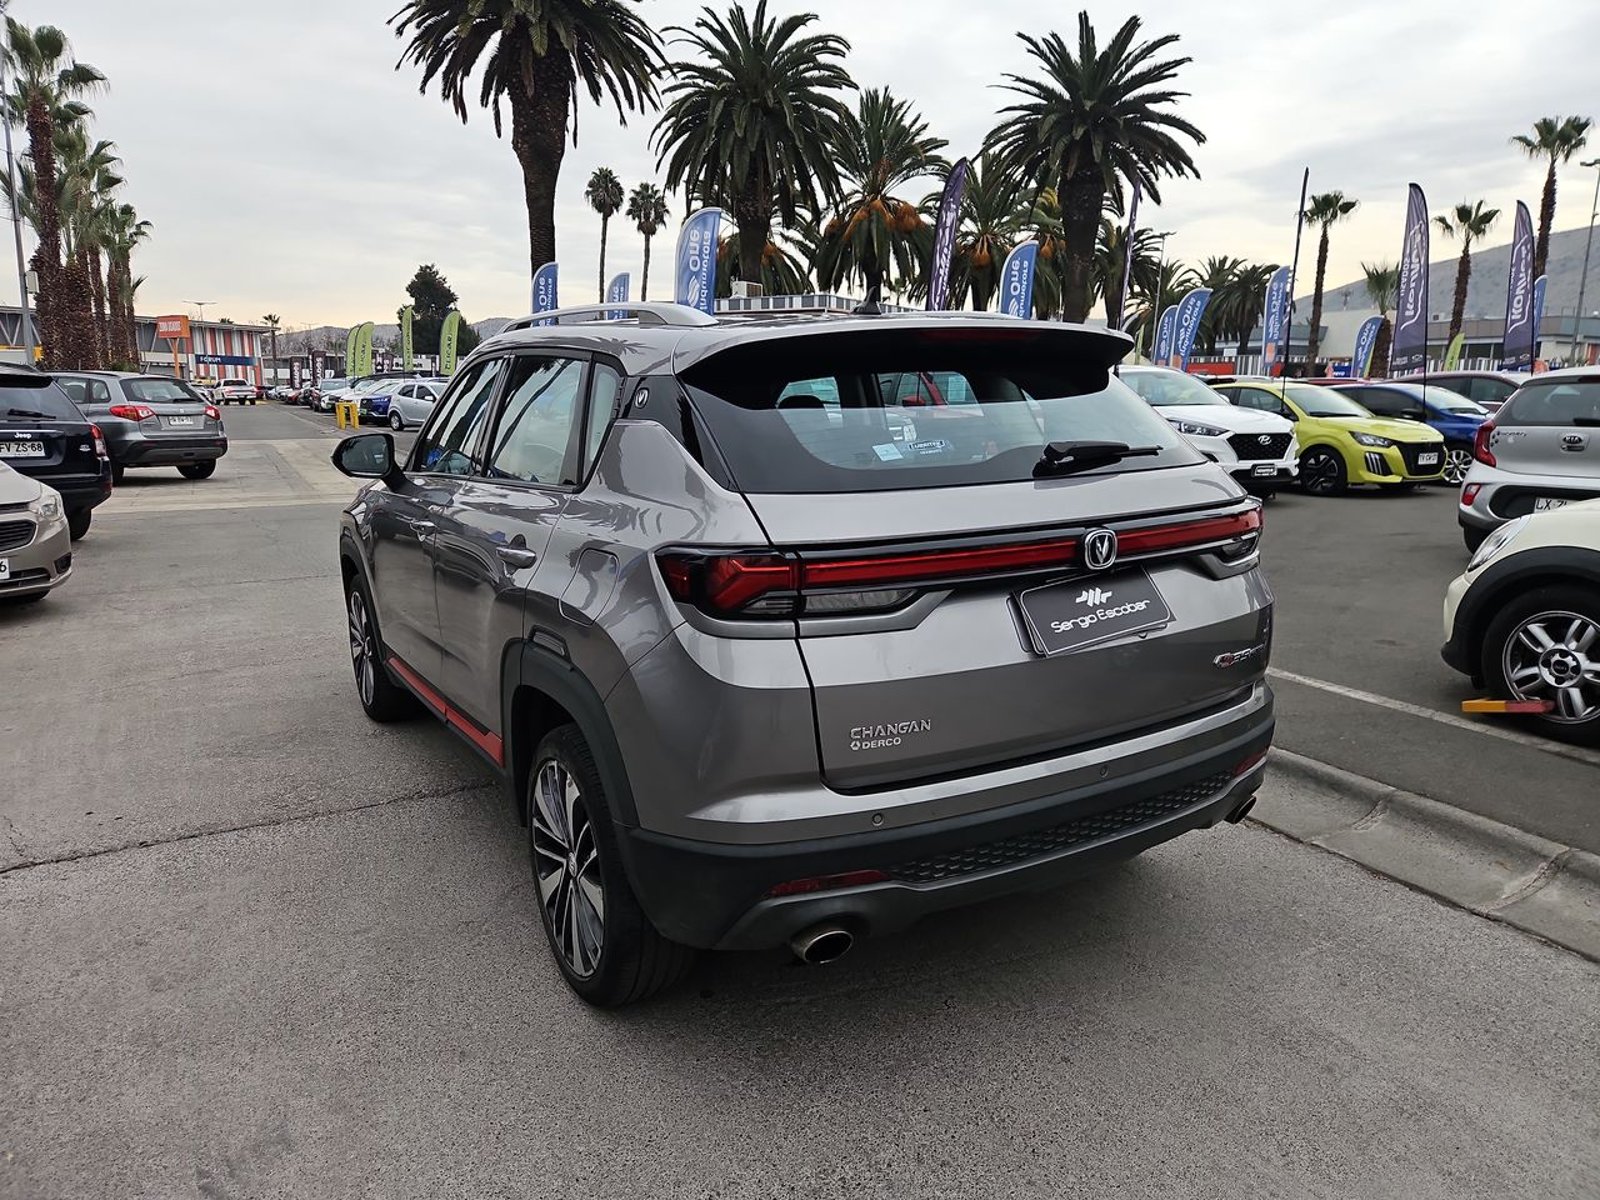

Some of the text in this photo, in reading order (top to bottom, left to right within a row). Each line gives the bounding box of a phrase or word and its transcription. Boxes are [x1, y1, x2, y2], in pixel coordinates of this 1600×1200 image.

[1096, 600, 1151, 620] Escobar
[850, 719, 931, 739] CHANGAN
[862, 736, 902, 749] DERCO
